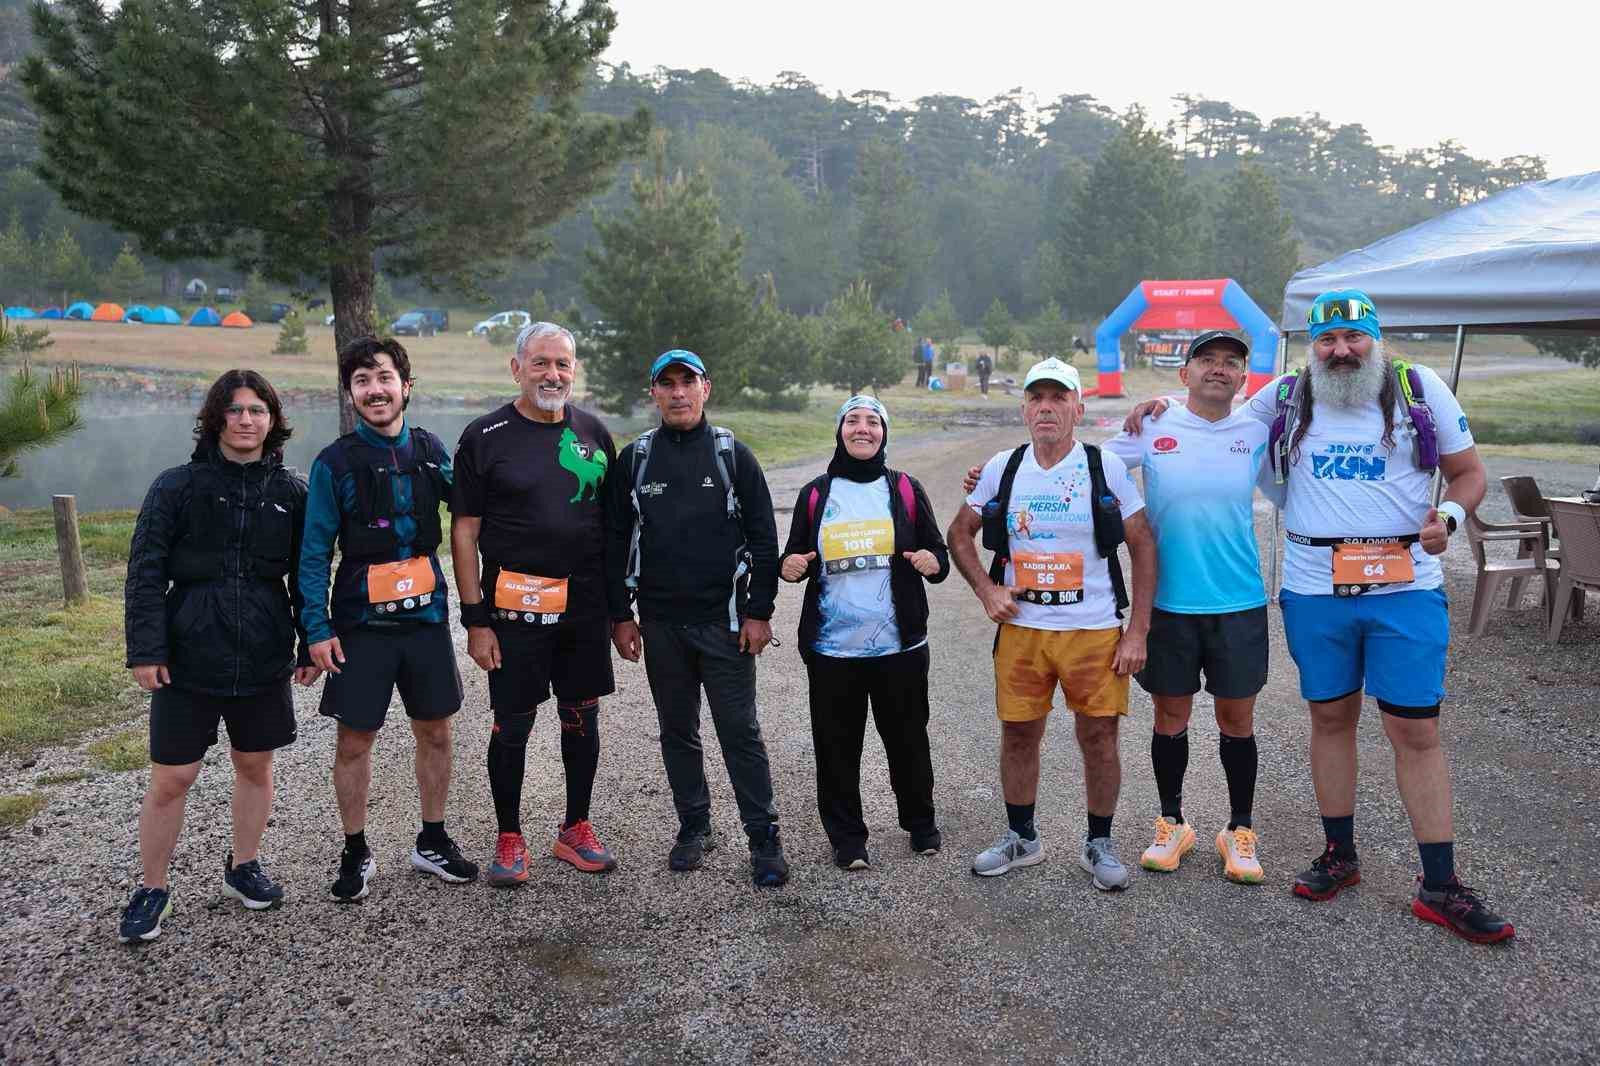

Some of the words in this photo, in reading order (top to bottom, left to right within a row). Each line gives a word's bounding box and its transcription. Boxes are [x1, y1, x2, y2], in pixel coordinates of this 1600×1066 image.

[843, 538, 873, 551] 1016
[1363, 563, 1385, 577] 64
[396, 578, 414, 592] 67
[1037, 572, 1056, 585] 56
[522, 594, 541, 607] 62
[1059, 591, 1079, 603] 50K
